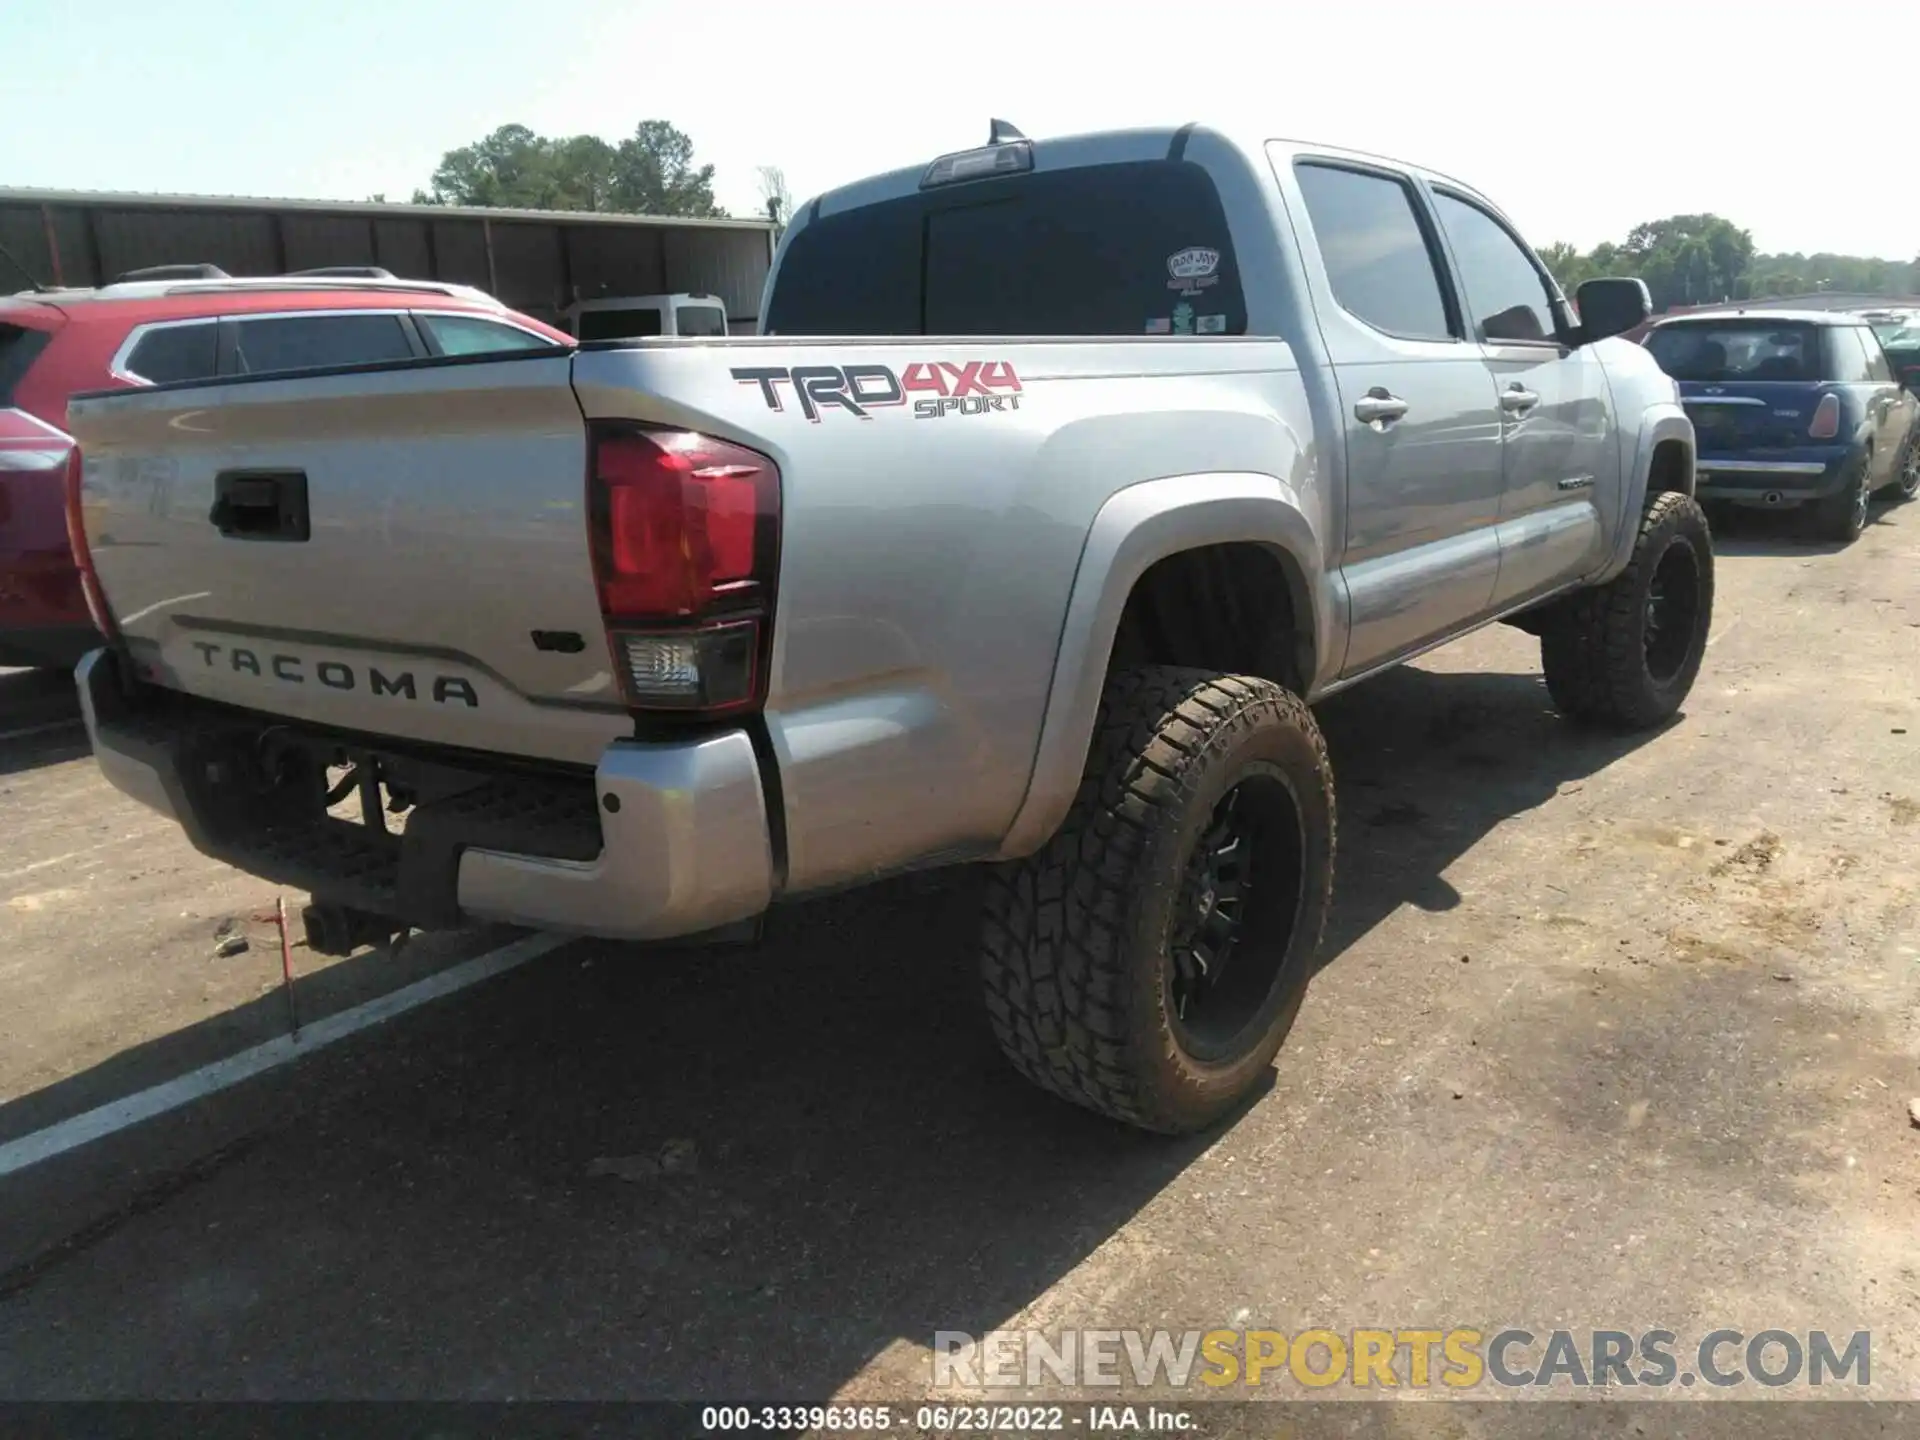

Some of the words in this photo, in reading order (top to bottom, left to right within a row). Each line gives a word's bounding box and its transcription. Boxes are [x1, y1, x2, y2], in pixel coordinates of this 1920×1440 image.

[730, 365, 907, 424] TRD
[914, 393, 1022, 420] SPORT
[192, 641, 479, 707] TACOMA
